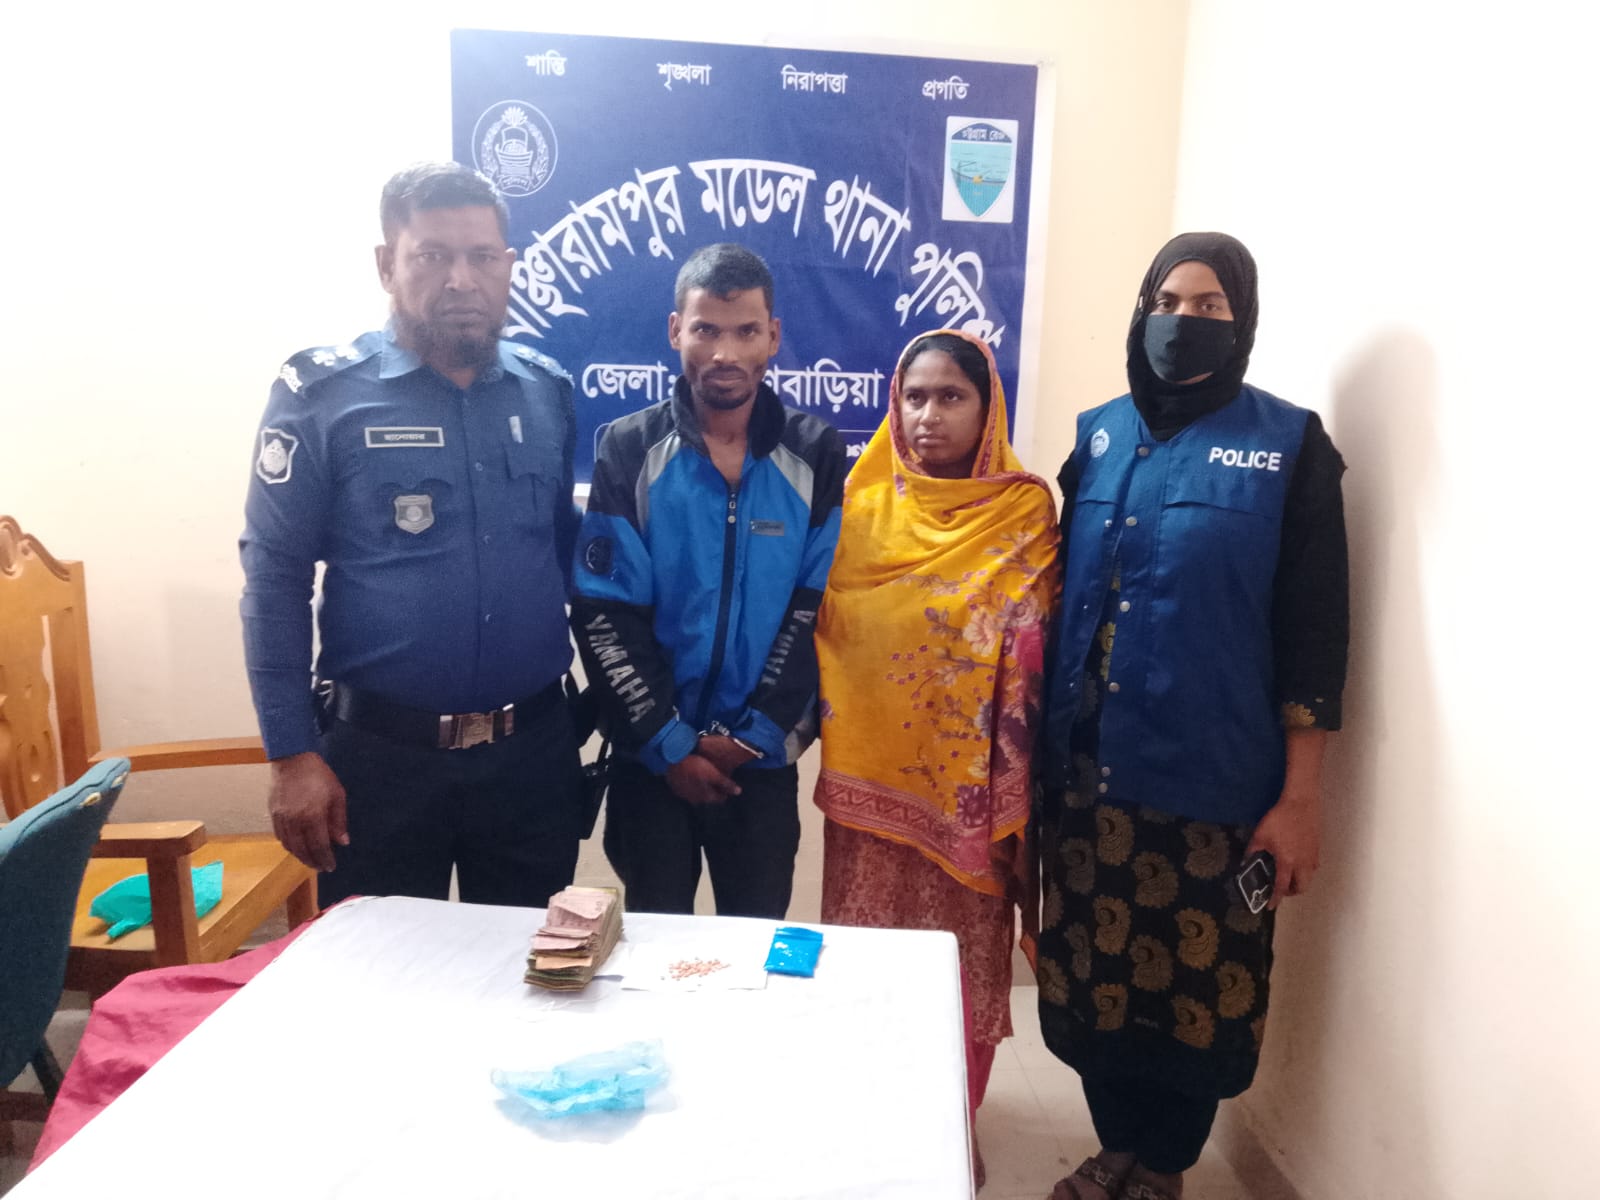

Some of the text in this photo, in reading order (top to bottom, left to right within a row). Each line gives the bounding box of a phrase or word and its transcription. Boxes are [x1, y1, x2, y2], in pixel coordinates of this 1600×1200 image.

[525, 49, 567, 76] শান্তি
[780, 64, 848, 94] নিরাপত্তা
[922, 75, 970, 101] প্রগতি
[688, 158, 817, 238] মডেল
[824, 174, 911, 279] থানা
[1208, 446, 1283, 472] POLICE
